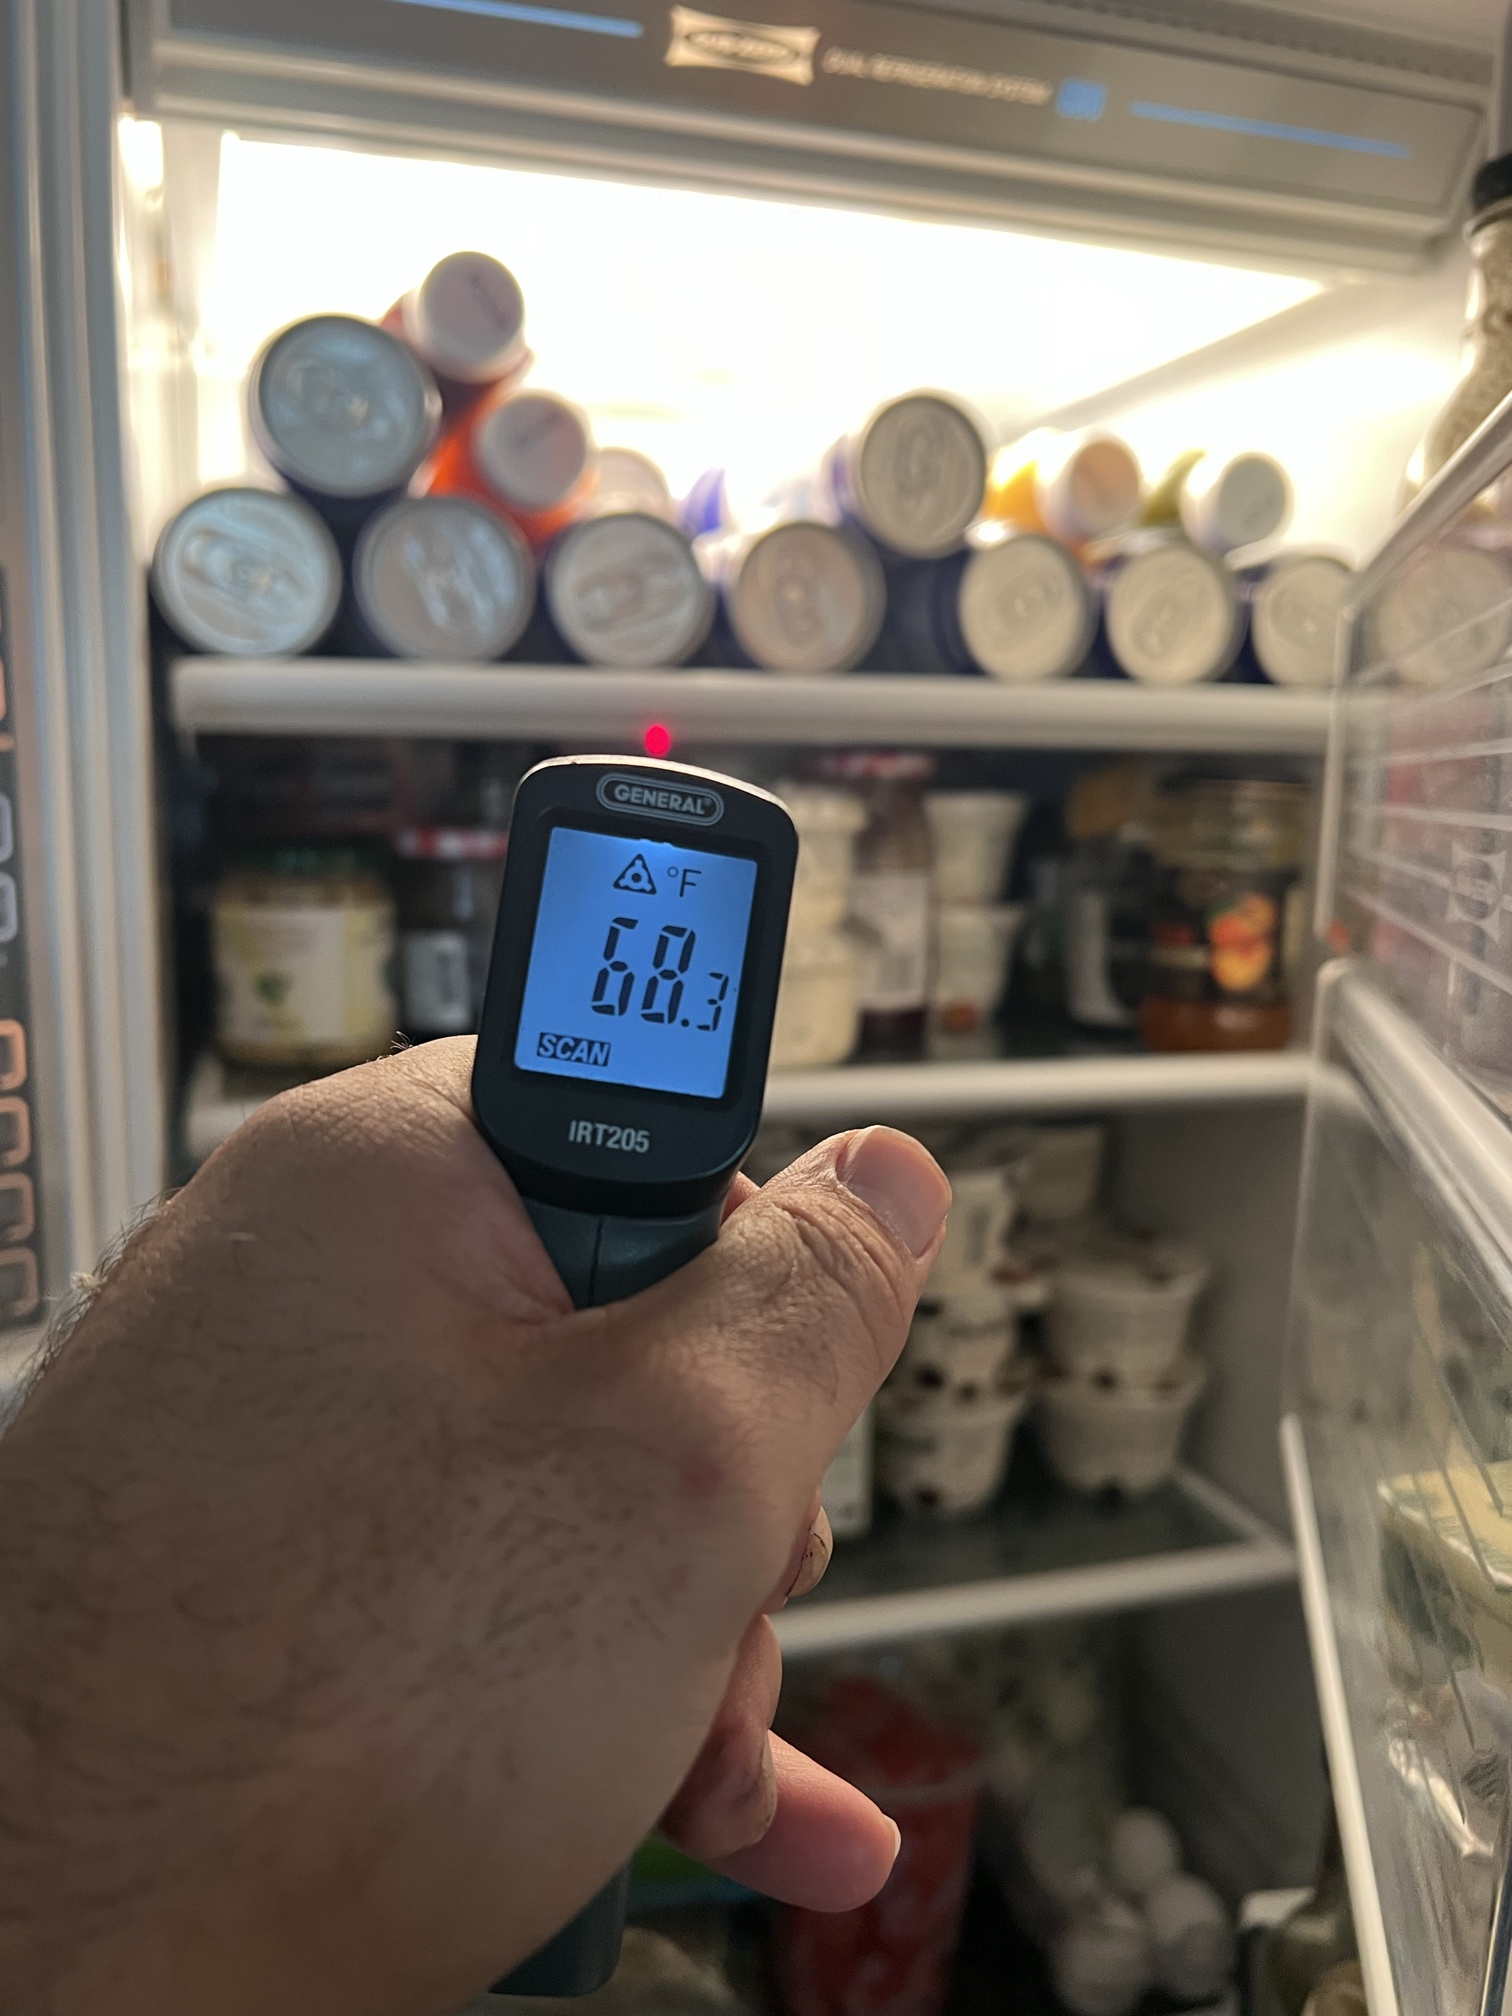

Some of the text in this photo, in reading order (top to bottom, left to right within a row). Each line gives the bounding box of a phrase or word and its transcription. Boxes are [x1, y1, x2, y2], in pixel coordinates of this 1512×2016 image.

[591, 916, 729, 1031] 68.3
[538, 1033, 610, 1066] SCAN
[568, 1120, 650, 1153] IRT205
